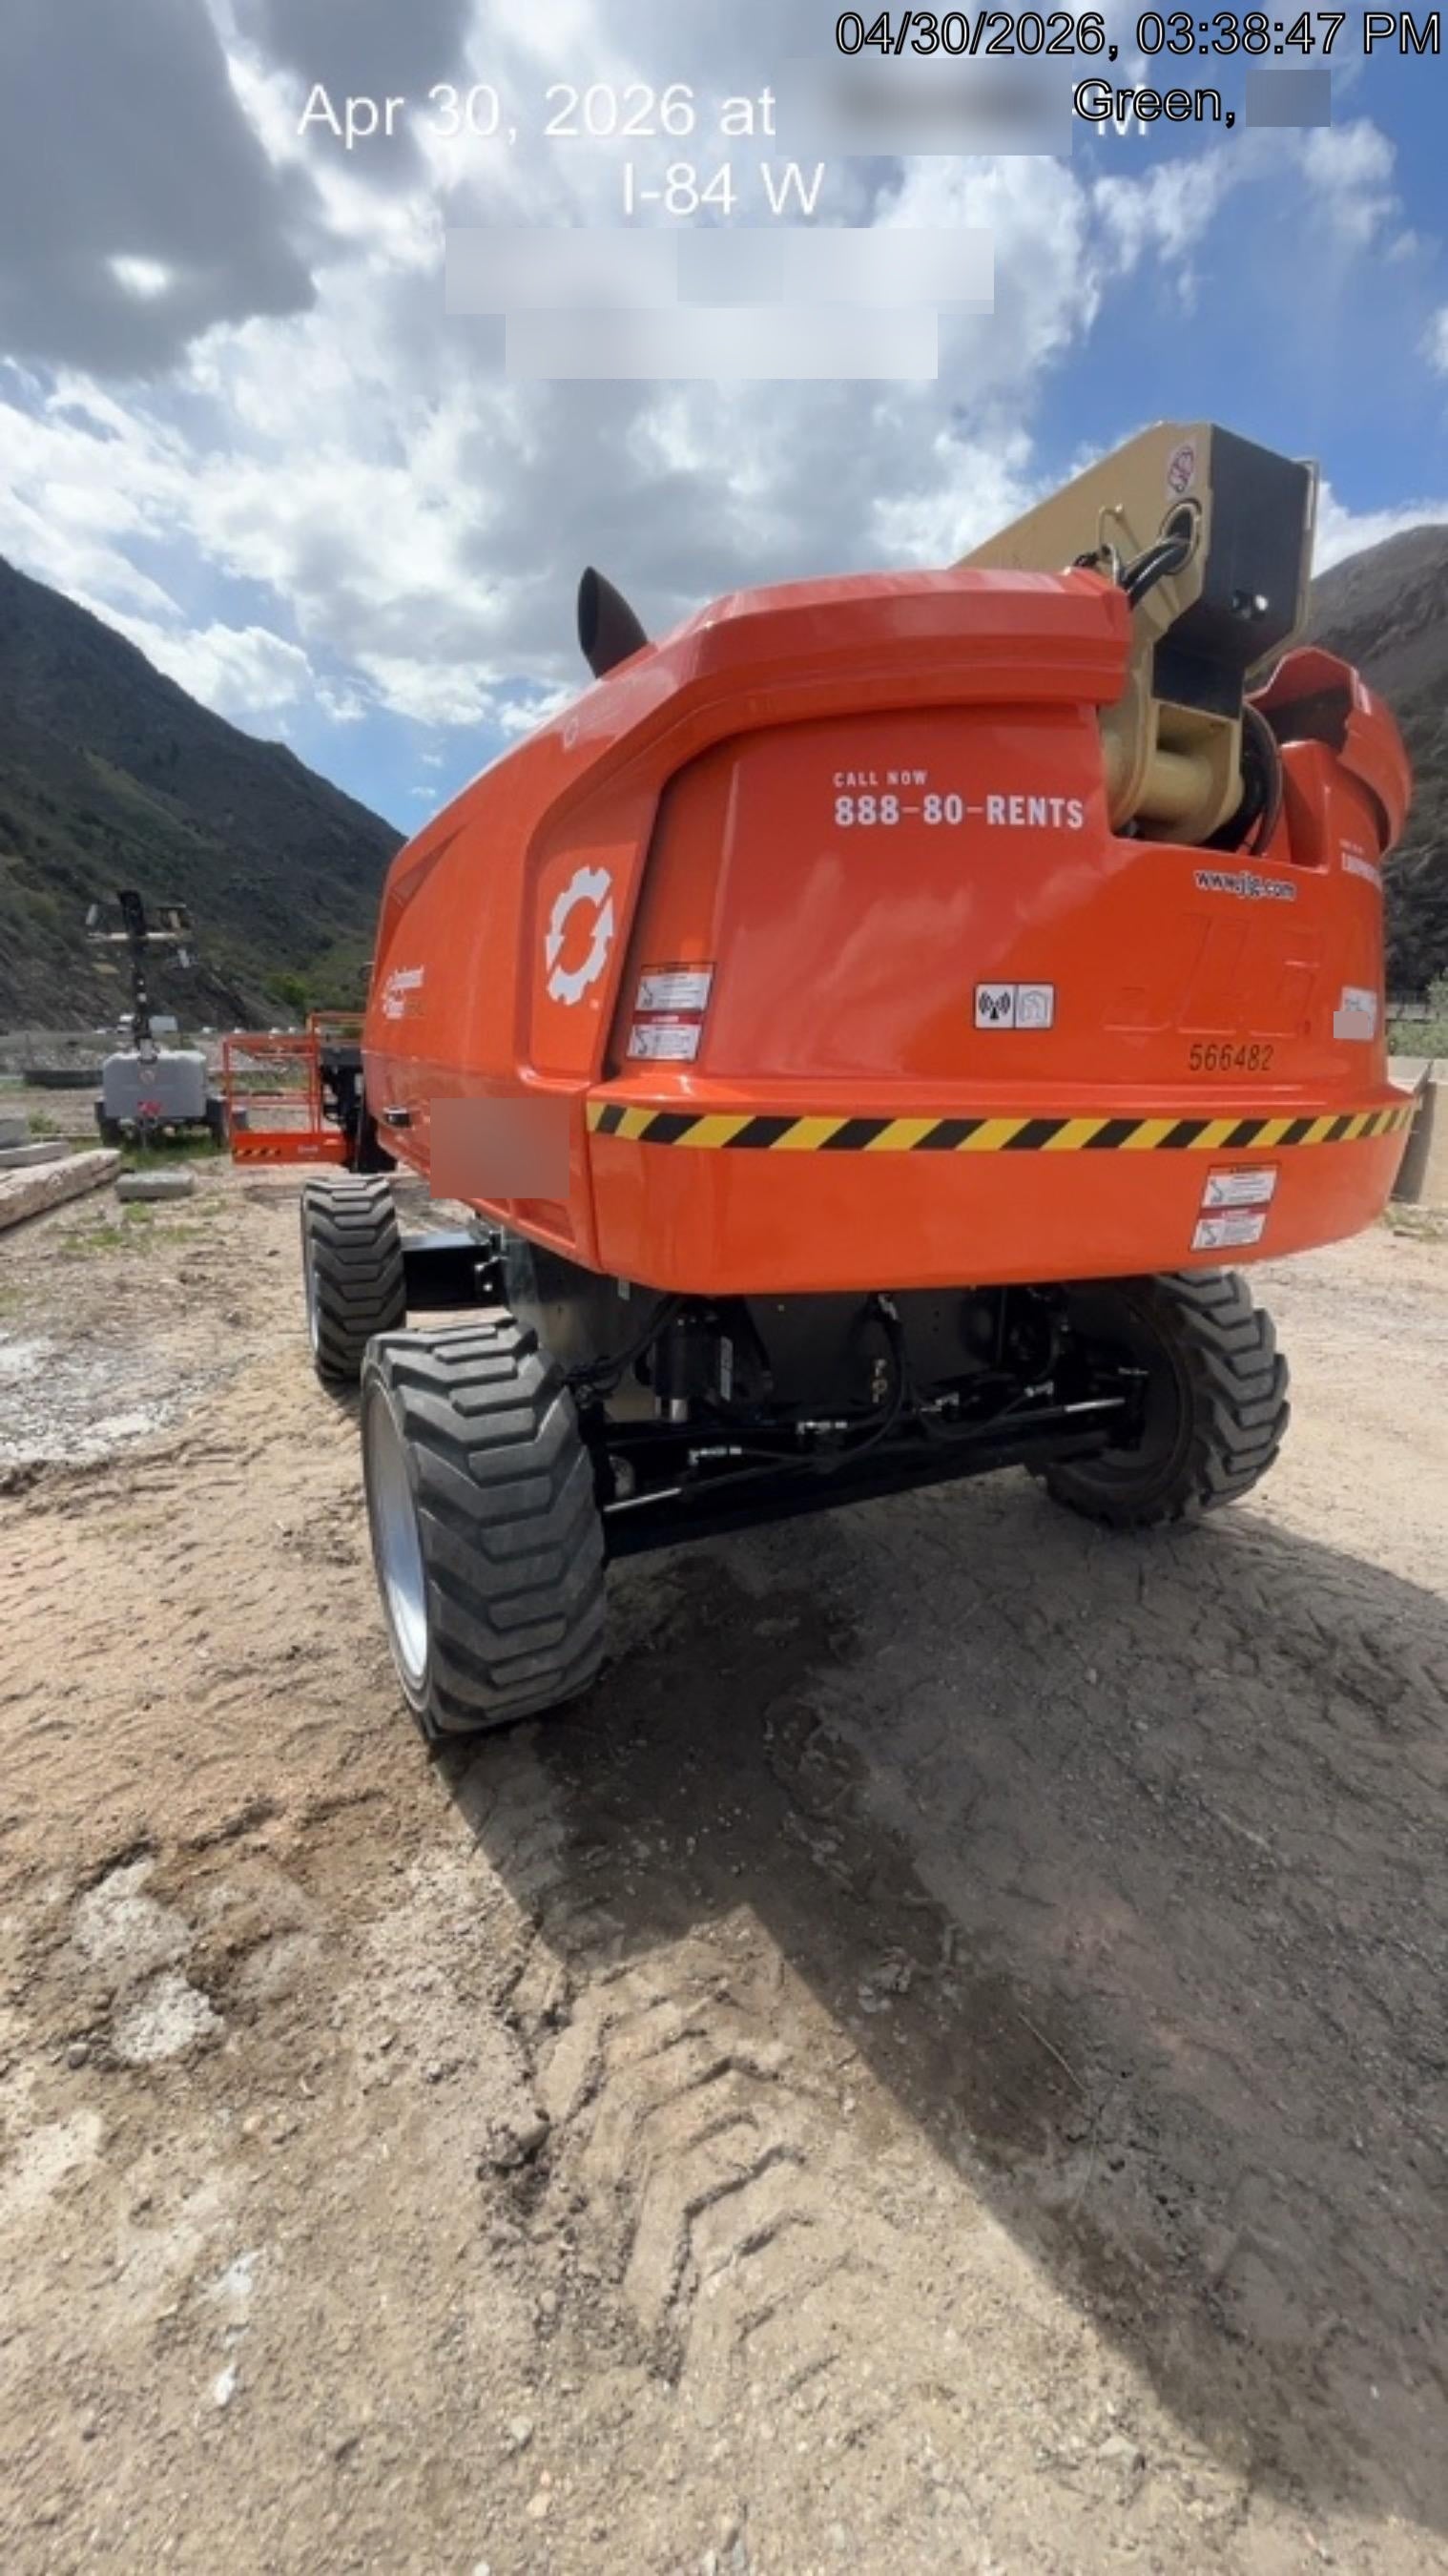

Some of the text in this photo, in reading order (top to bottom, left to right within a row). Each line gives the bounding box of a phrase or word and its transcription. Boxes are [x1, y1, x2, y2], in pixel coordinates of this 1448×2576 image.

[833, 769, 929, 788] CALL NOW
[834, 793, 1085, 829] 888-80-RENTS
[1189, 1043, 1274, 1071] 566482
